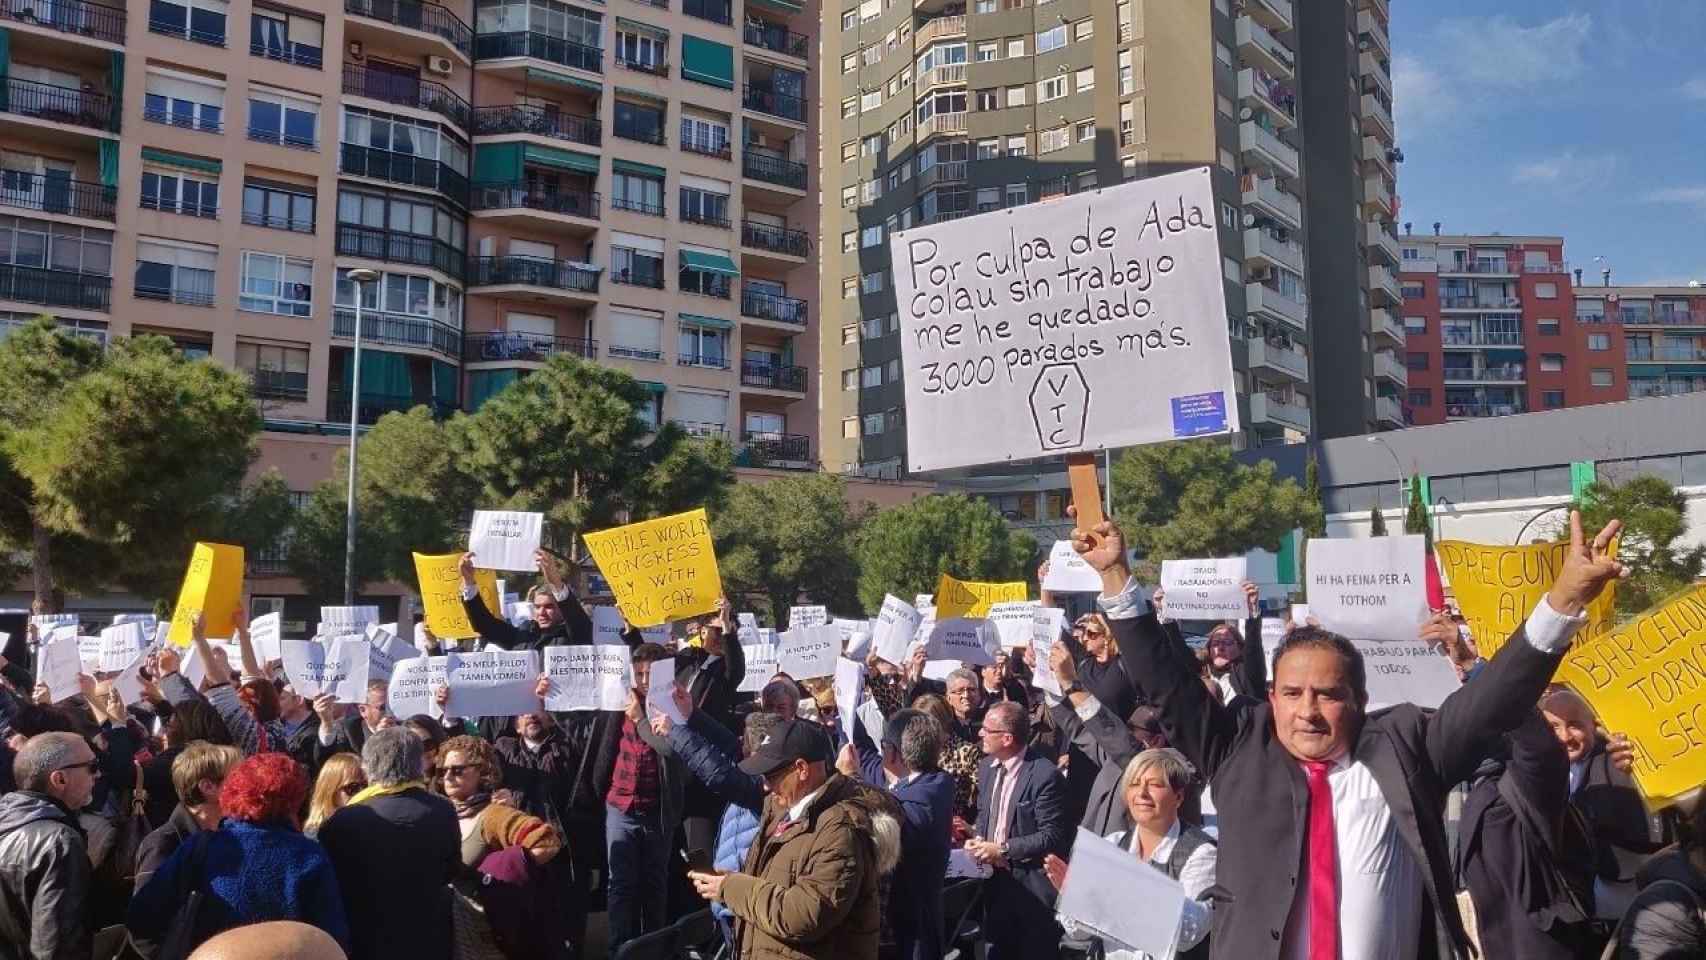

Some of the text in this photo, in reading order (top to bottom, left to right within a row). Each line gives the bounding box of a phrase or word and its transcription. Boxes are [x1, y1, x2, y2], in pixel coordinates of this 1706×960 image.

[908, 194, 1214, 290] Por culpa de Ada
[910, 252, 1176, 321] colau sin trabajo
[914, 321, 963, 351] me
[972, 313, 1014, 346] he
[1003, 332, 1105, 383] parados
[1116, 320, 1193, 361] más.
[653, 517, 707, 543] WORLD
[608, 542, 702, 578] CONGRESS
[648, 566, 697, 588] WITH
[1315, 573, 1411, 586] HI HA FEINA PER A
[661, 587, 699, 612] CAR
[1196, 591, 1208, 599] NO
[1339, 594, 1387, 607] TOTHOM
[499, 659, 528, 668] FILLOS
[549, 654, 568, 664] NOS
[492, 671, 527, 681] COMEN
[571, 667, 596, 675] TIRAN
[1374, 664, 1413, 675] TODOS
